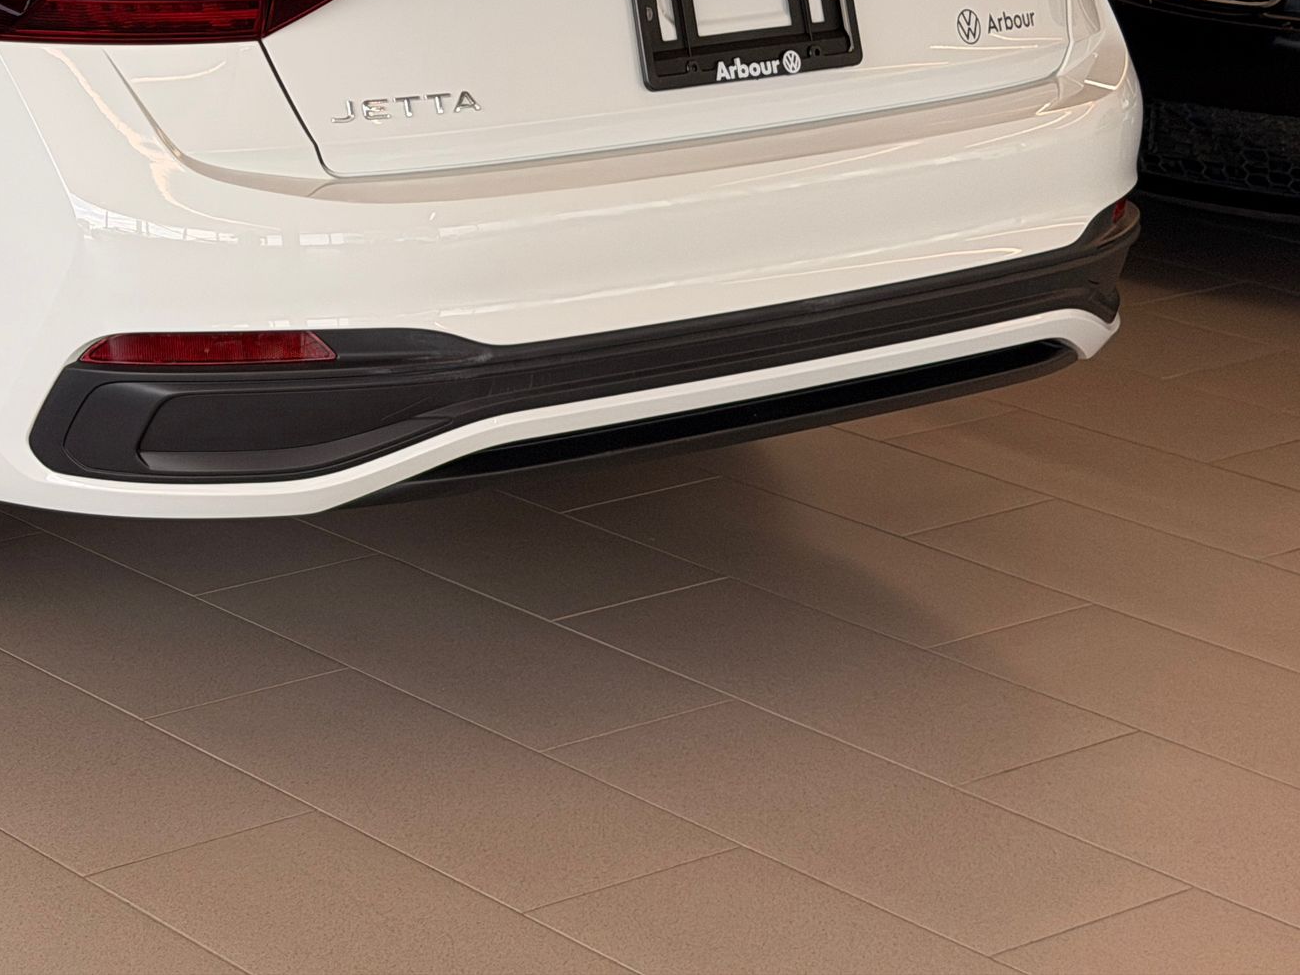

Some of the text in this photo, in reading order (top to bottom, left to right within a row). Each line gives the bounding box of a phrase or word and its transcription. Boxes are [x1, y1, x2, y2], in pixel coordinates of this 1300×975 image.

[987, 11, 1035, 34] Arbour
[716, 57, 780, 81] Arbour
[331, 90, 481, 123] JETTA
